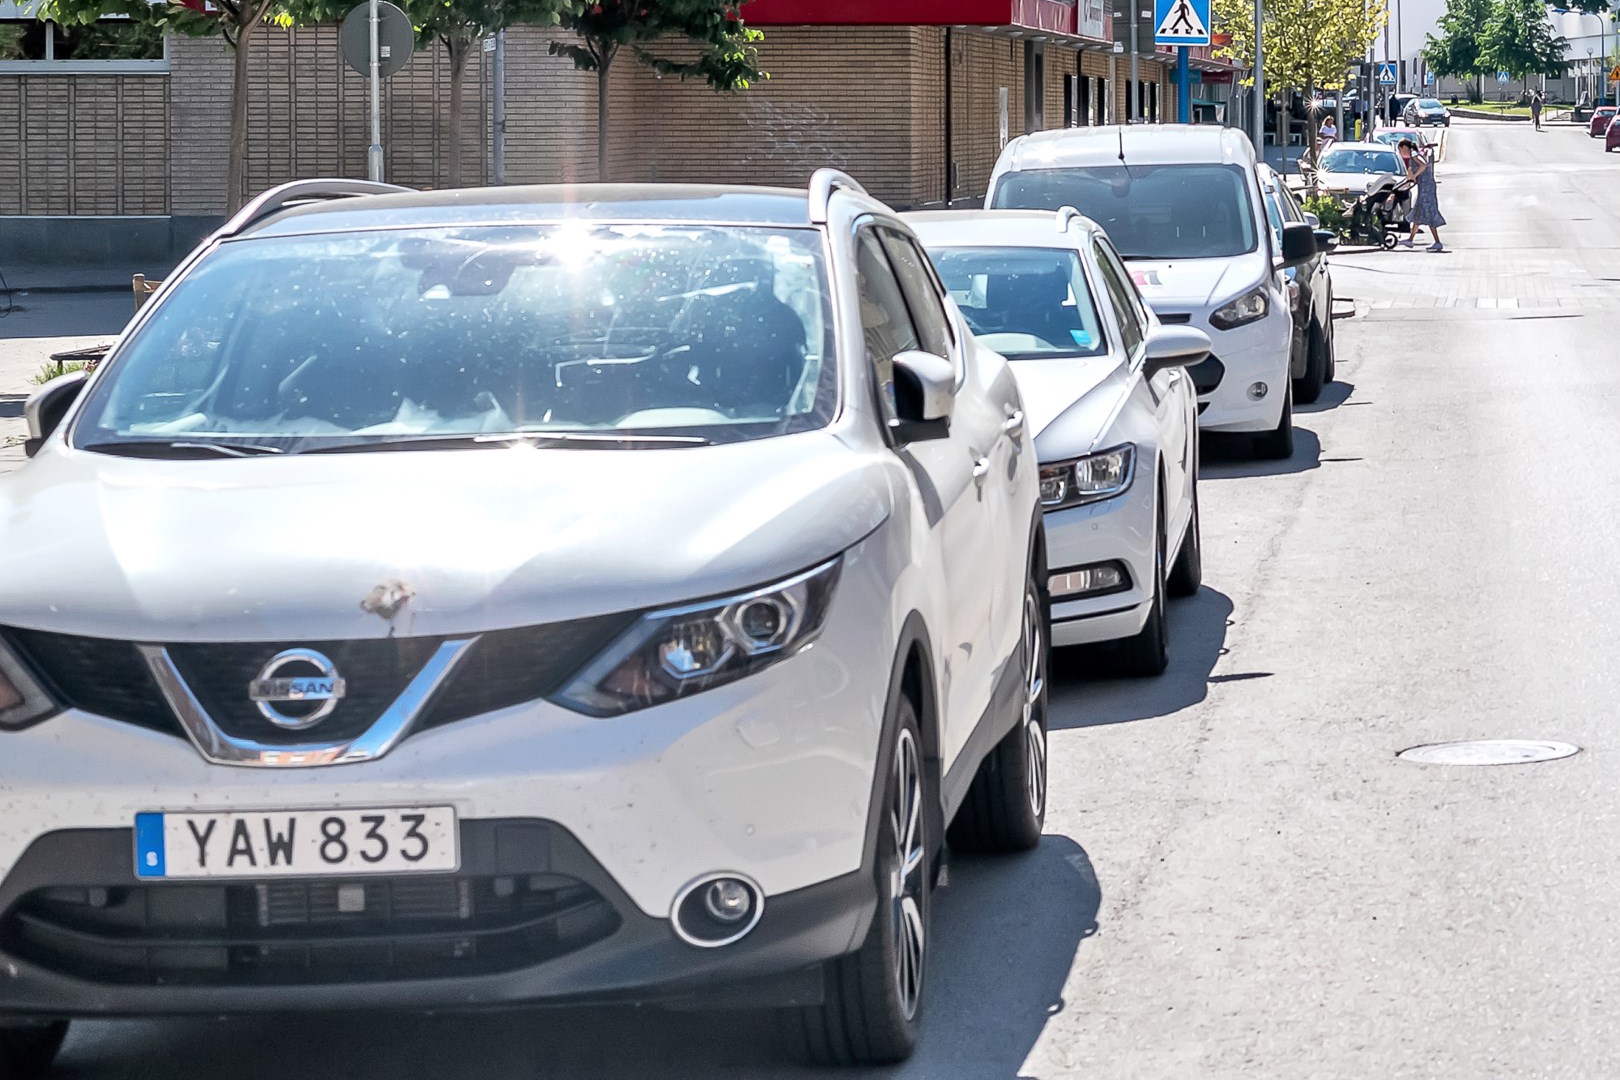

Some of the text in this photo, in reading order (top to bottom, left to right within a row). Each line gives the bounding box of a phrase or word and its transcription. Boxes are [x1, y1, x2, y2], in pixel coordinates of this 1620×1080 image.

[259, 681, 334, 696] NISSAN
[186, 814, 429, 868] YAW 833
